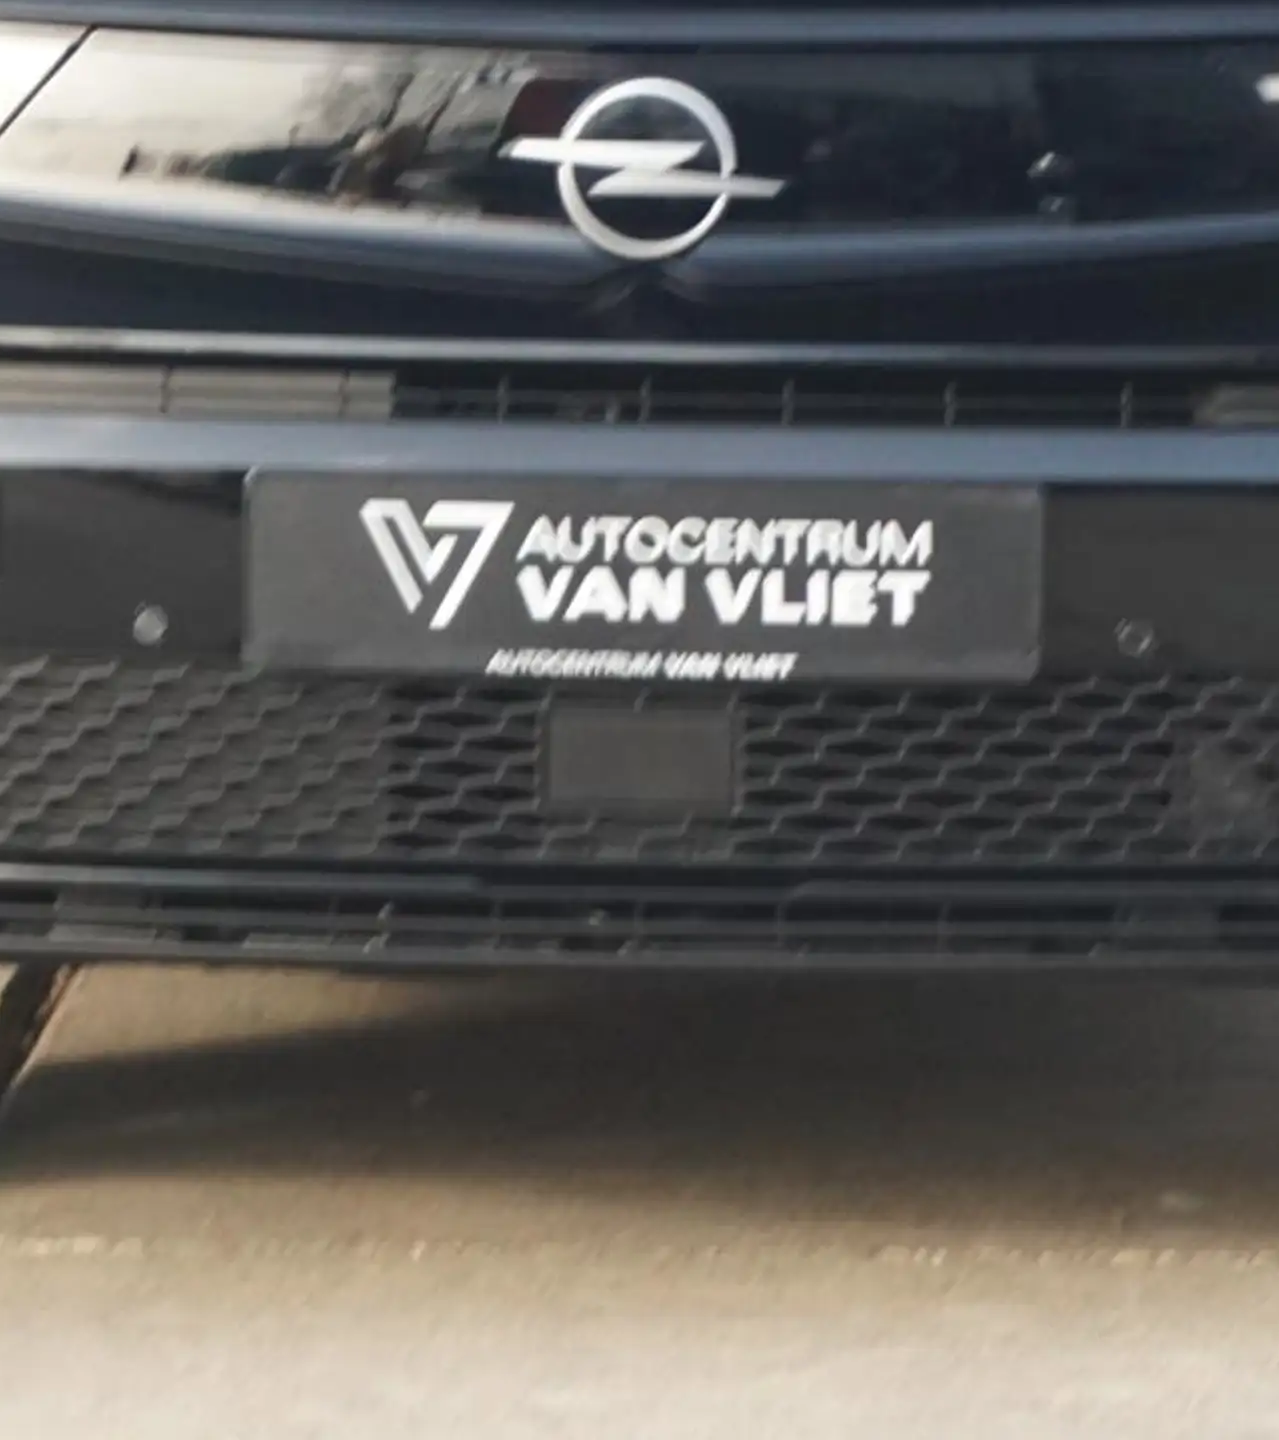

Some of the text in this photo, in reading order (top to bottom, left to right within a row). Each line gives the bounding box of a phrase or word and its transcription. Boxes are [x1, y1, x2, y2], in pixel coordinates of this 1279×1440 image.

[516, 514, 933, 567] AUTOCENTRUM
[516, 564, 931, 626] VAN VLIET
[485, 648, 799, 681] AUTOCENTRUM VAN VLIET
